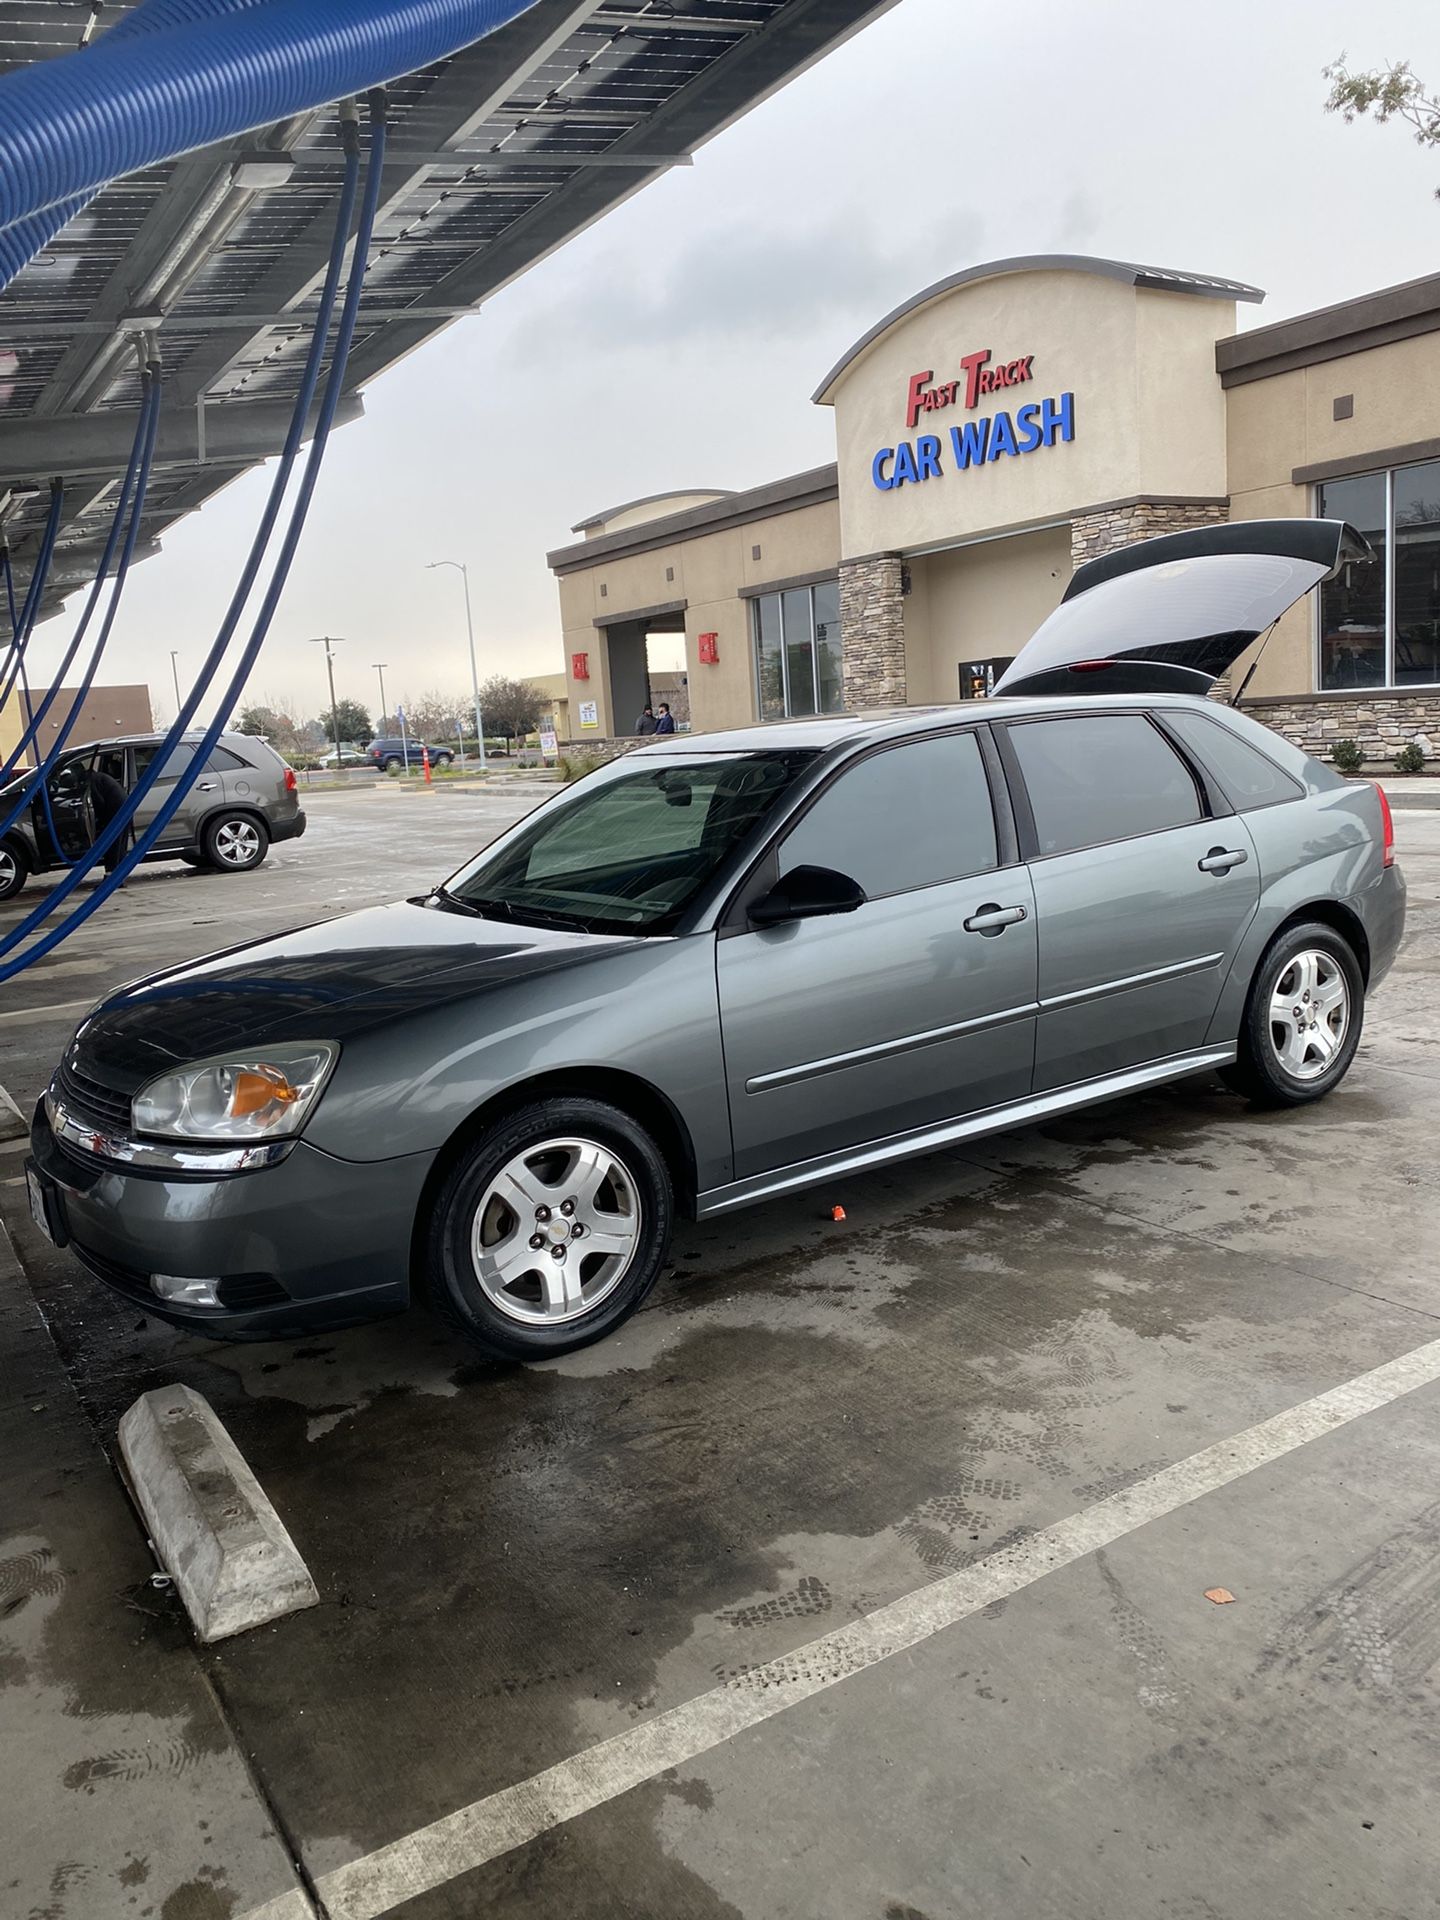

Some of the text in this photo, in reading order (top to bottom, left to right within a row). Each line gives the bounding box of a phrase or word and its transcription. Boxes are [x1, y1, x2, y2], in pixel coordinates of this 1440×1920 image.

[906, 349, 1035, 428] FAST TRACK
[872, 392, 1075, 491] CAR WASH
